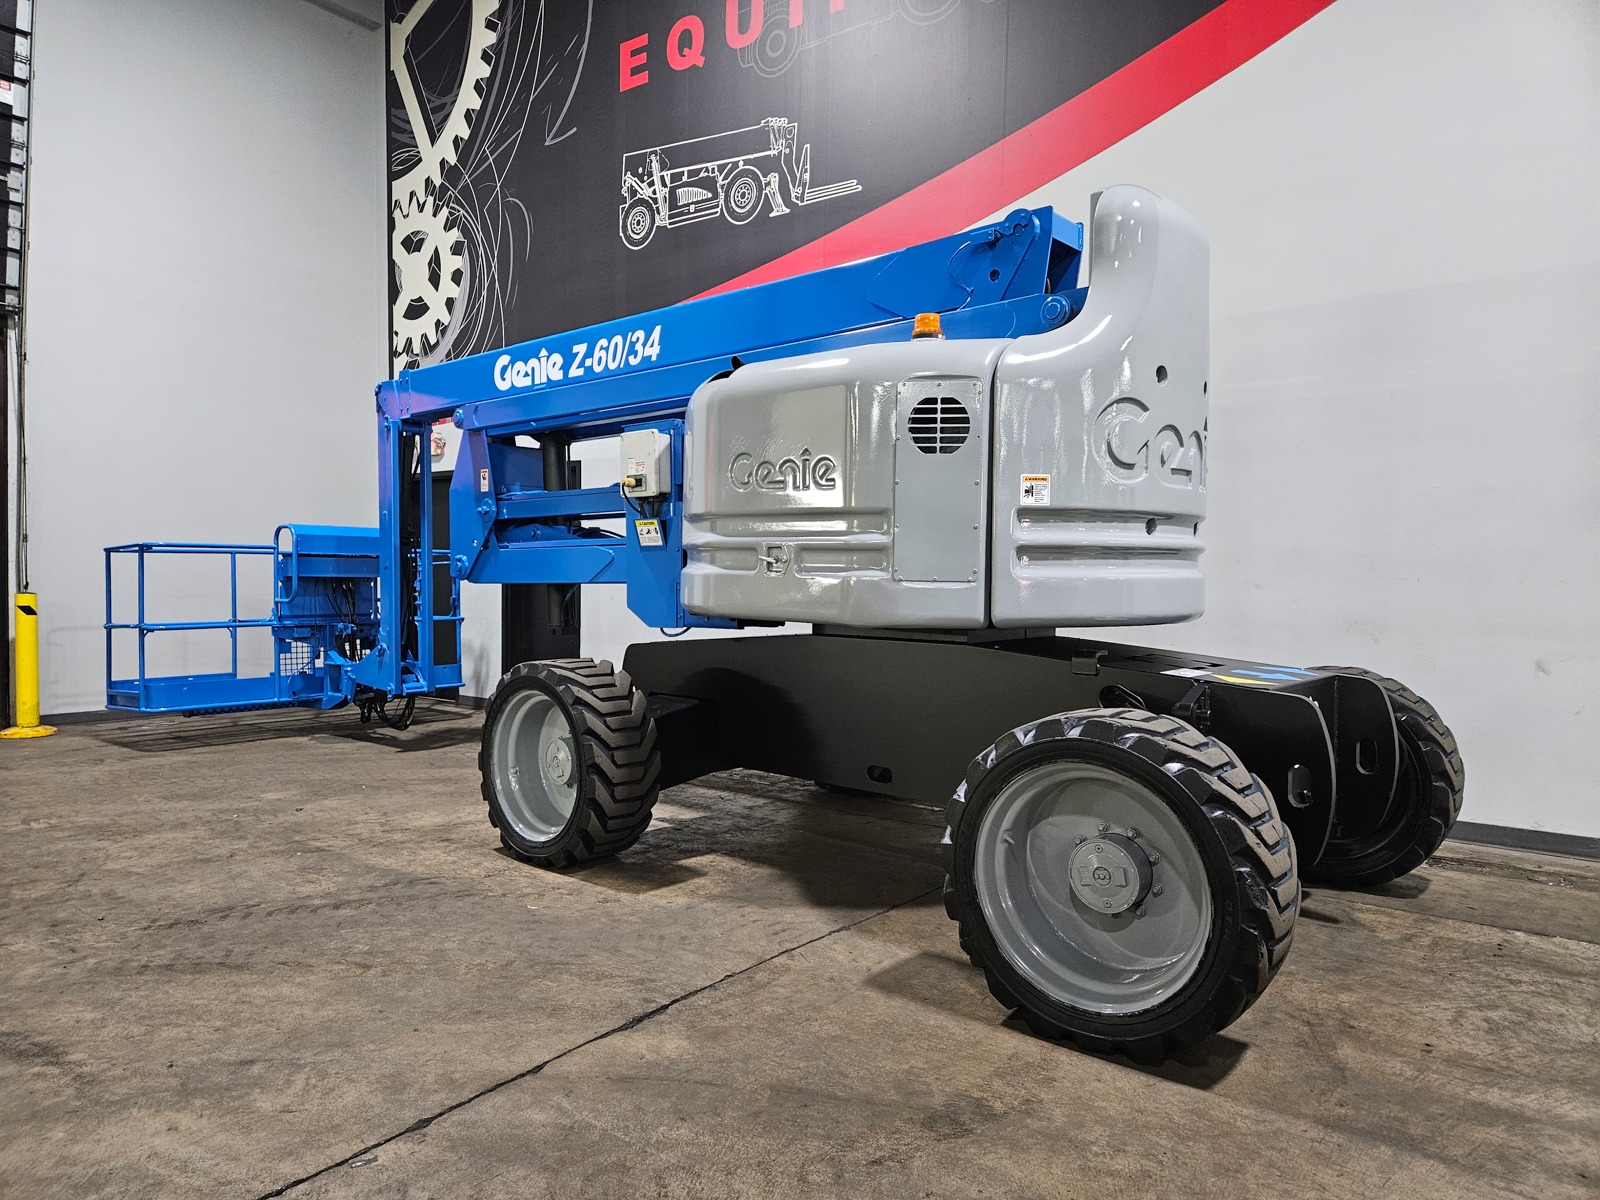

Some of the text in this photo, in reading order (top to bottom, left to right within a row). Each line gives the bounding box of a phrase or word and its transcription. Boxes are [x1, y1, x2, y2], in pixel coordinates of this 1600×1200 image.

[494, 325, 662, 391] Genie Z-60/34
[727, 446, 836, 492] Genie
